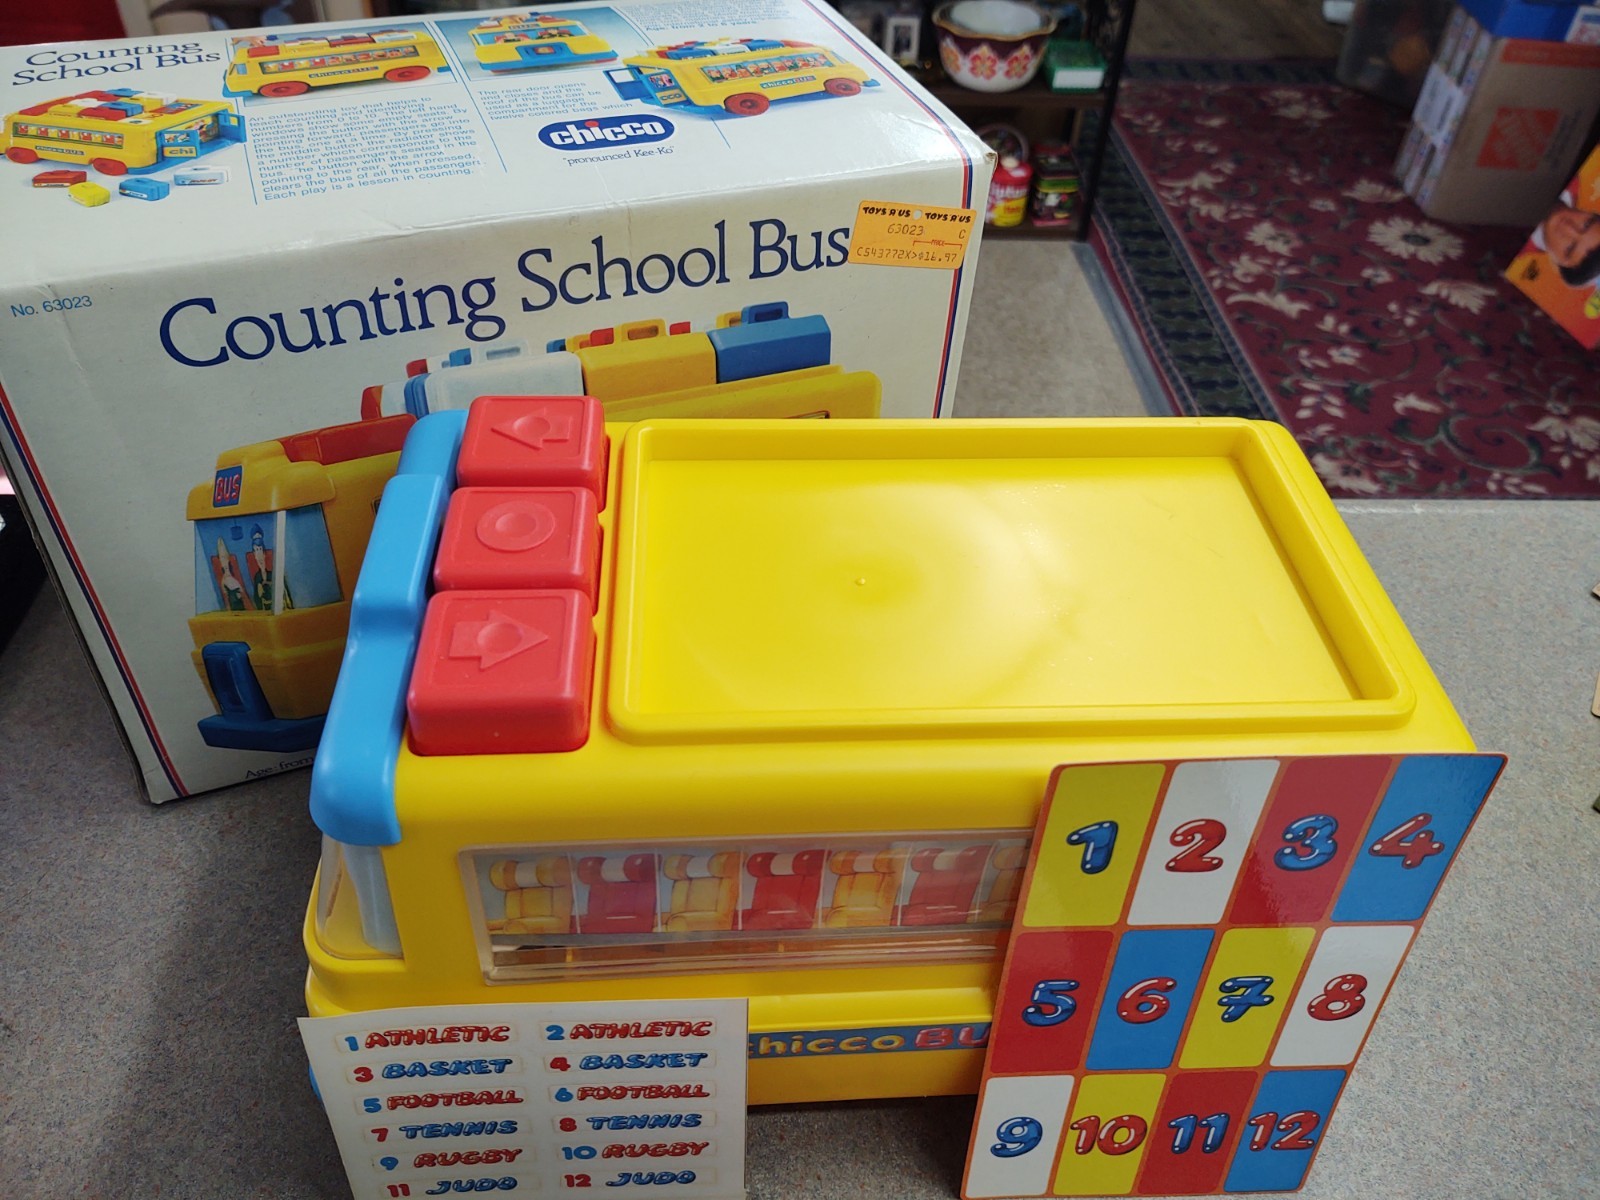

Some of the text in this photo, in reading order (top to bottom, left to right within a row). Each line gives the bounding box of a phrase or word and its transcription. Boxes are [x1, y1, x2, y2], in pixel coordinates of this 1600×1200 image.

[26, 42, 203, 66] Counting
[12, 52, 220, 86] School Bus
[549, 120, 666, 144] chicco
[259, 162, 306, 172] number
[327, 148, 396, 163] passengers
[402, 144, 440, 153] seated
[318, 162, 356, 170] button
[262, 174, 312, 186] pointing
[388, 160, 420, 168] when
[263, 182, 301, 192] clears
[264, 190, 296, 200] Each
[302, 186, 327, 196] play
[358, 176, 398, 186] lesson
[862, 206, 886, 216] TOYS
[898, 210, 910, 218] US
[925, 212, 948, 220] TOYS
[959, 215, 971, 223] US
[888, 224, 966, 240] 63023 C
[160, 218, 850, 367] Counting School Bus
[10, 294, 93, 318] No. 63023
[216, 474, 240, 502] BUS
[1066, 819, 1120, 874] 1
[1164, 819, 1227, 872] 2
[1274, 814, 1339, 872] 3
[1368, 812, 1444, 870] 4
[1022, 979, 1080, 1026] 5
[1116, 977, 1177, 1024] 6
[1218, 975, 1274, 1023] 7
[1306, 973, 1368, 1022] 8
[344, 1025, 510, 1052] 1 ATHLETIC
[546, 1020, 712, 1040] 2 ATHLETIC
[748, 1026, 991, 1056] hicco BU
[353, 1058, 513, 1082] 3 BASKET
[550, 1052, 708, 1072] 4 BASKET
[364, 1090, 524, 1113] 5 FOOTBALL
[554, 1084, 710, 1103] 6 FOOTBALL
[370, 1120, 518, 1142] 7 TENNIS
[559, 1113, 702, 1132] 8 TENNIS
[1167, 1112, 1230, 1154] 11
[1247, 1110, 1321, 1151] 12
[990, 1115, 1044, 1158] 9
[1070, 1114, 1148, 1156] 10
[380, 1148, 524, 1171] 9 RUGBY
[561, 1142, 710, 1160] 10 RUGBY
[386, 1176, 518, 1198] 11 JUDO
[564, 1170, 697, 1188] 12 JUDO
